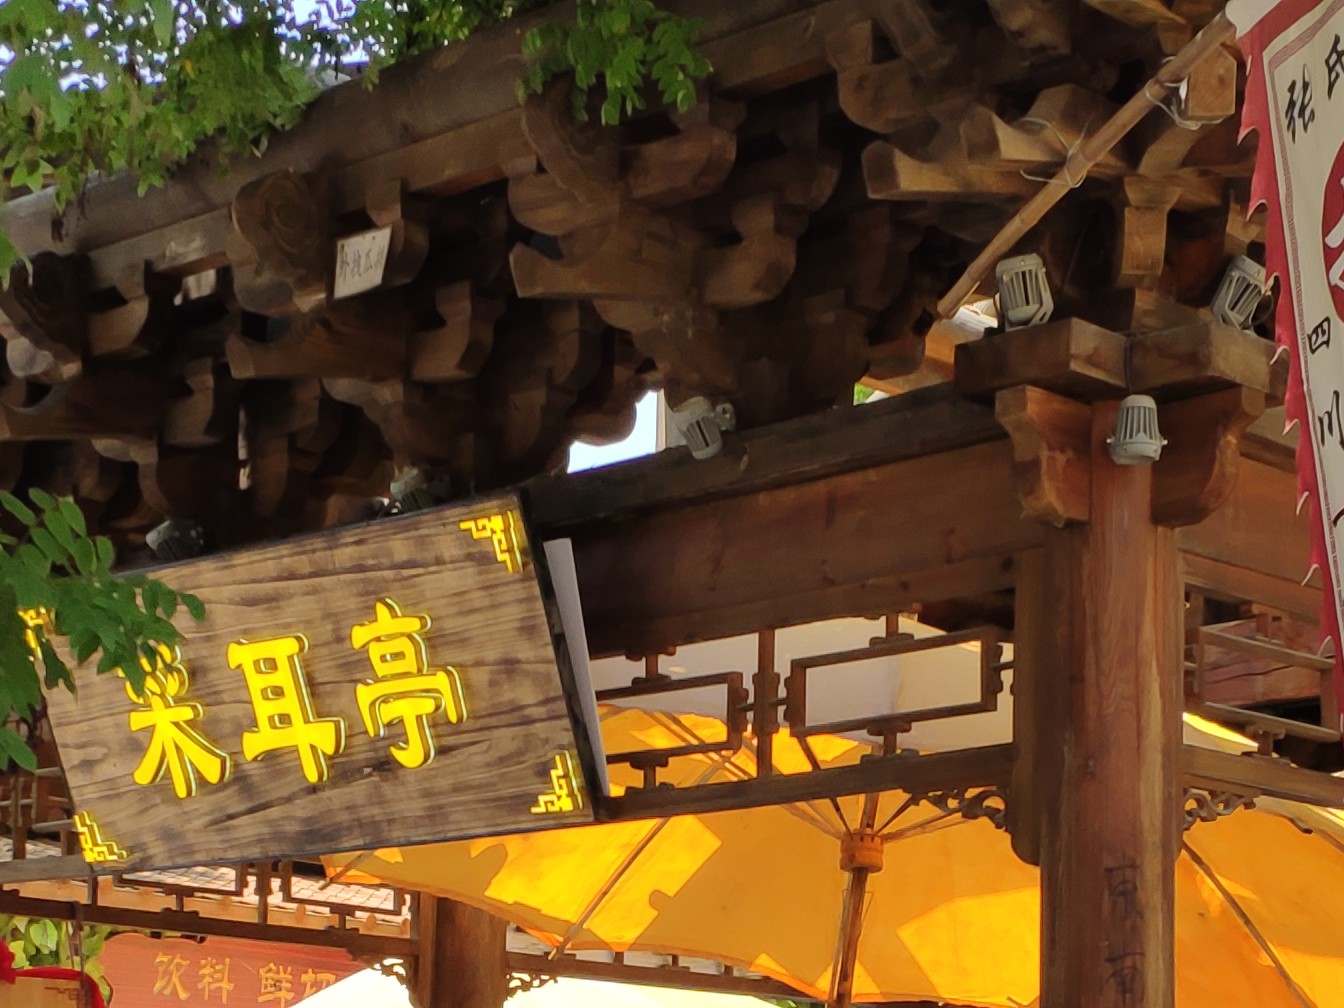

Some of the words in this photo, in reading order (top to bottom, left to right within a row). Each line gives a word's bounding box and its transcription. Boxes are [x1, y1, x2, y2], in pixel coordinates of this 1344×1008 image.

[120, 597, 468, 799] 采耳亭
[153, 951, 235, 1004] 饮料
